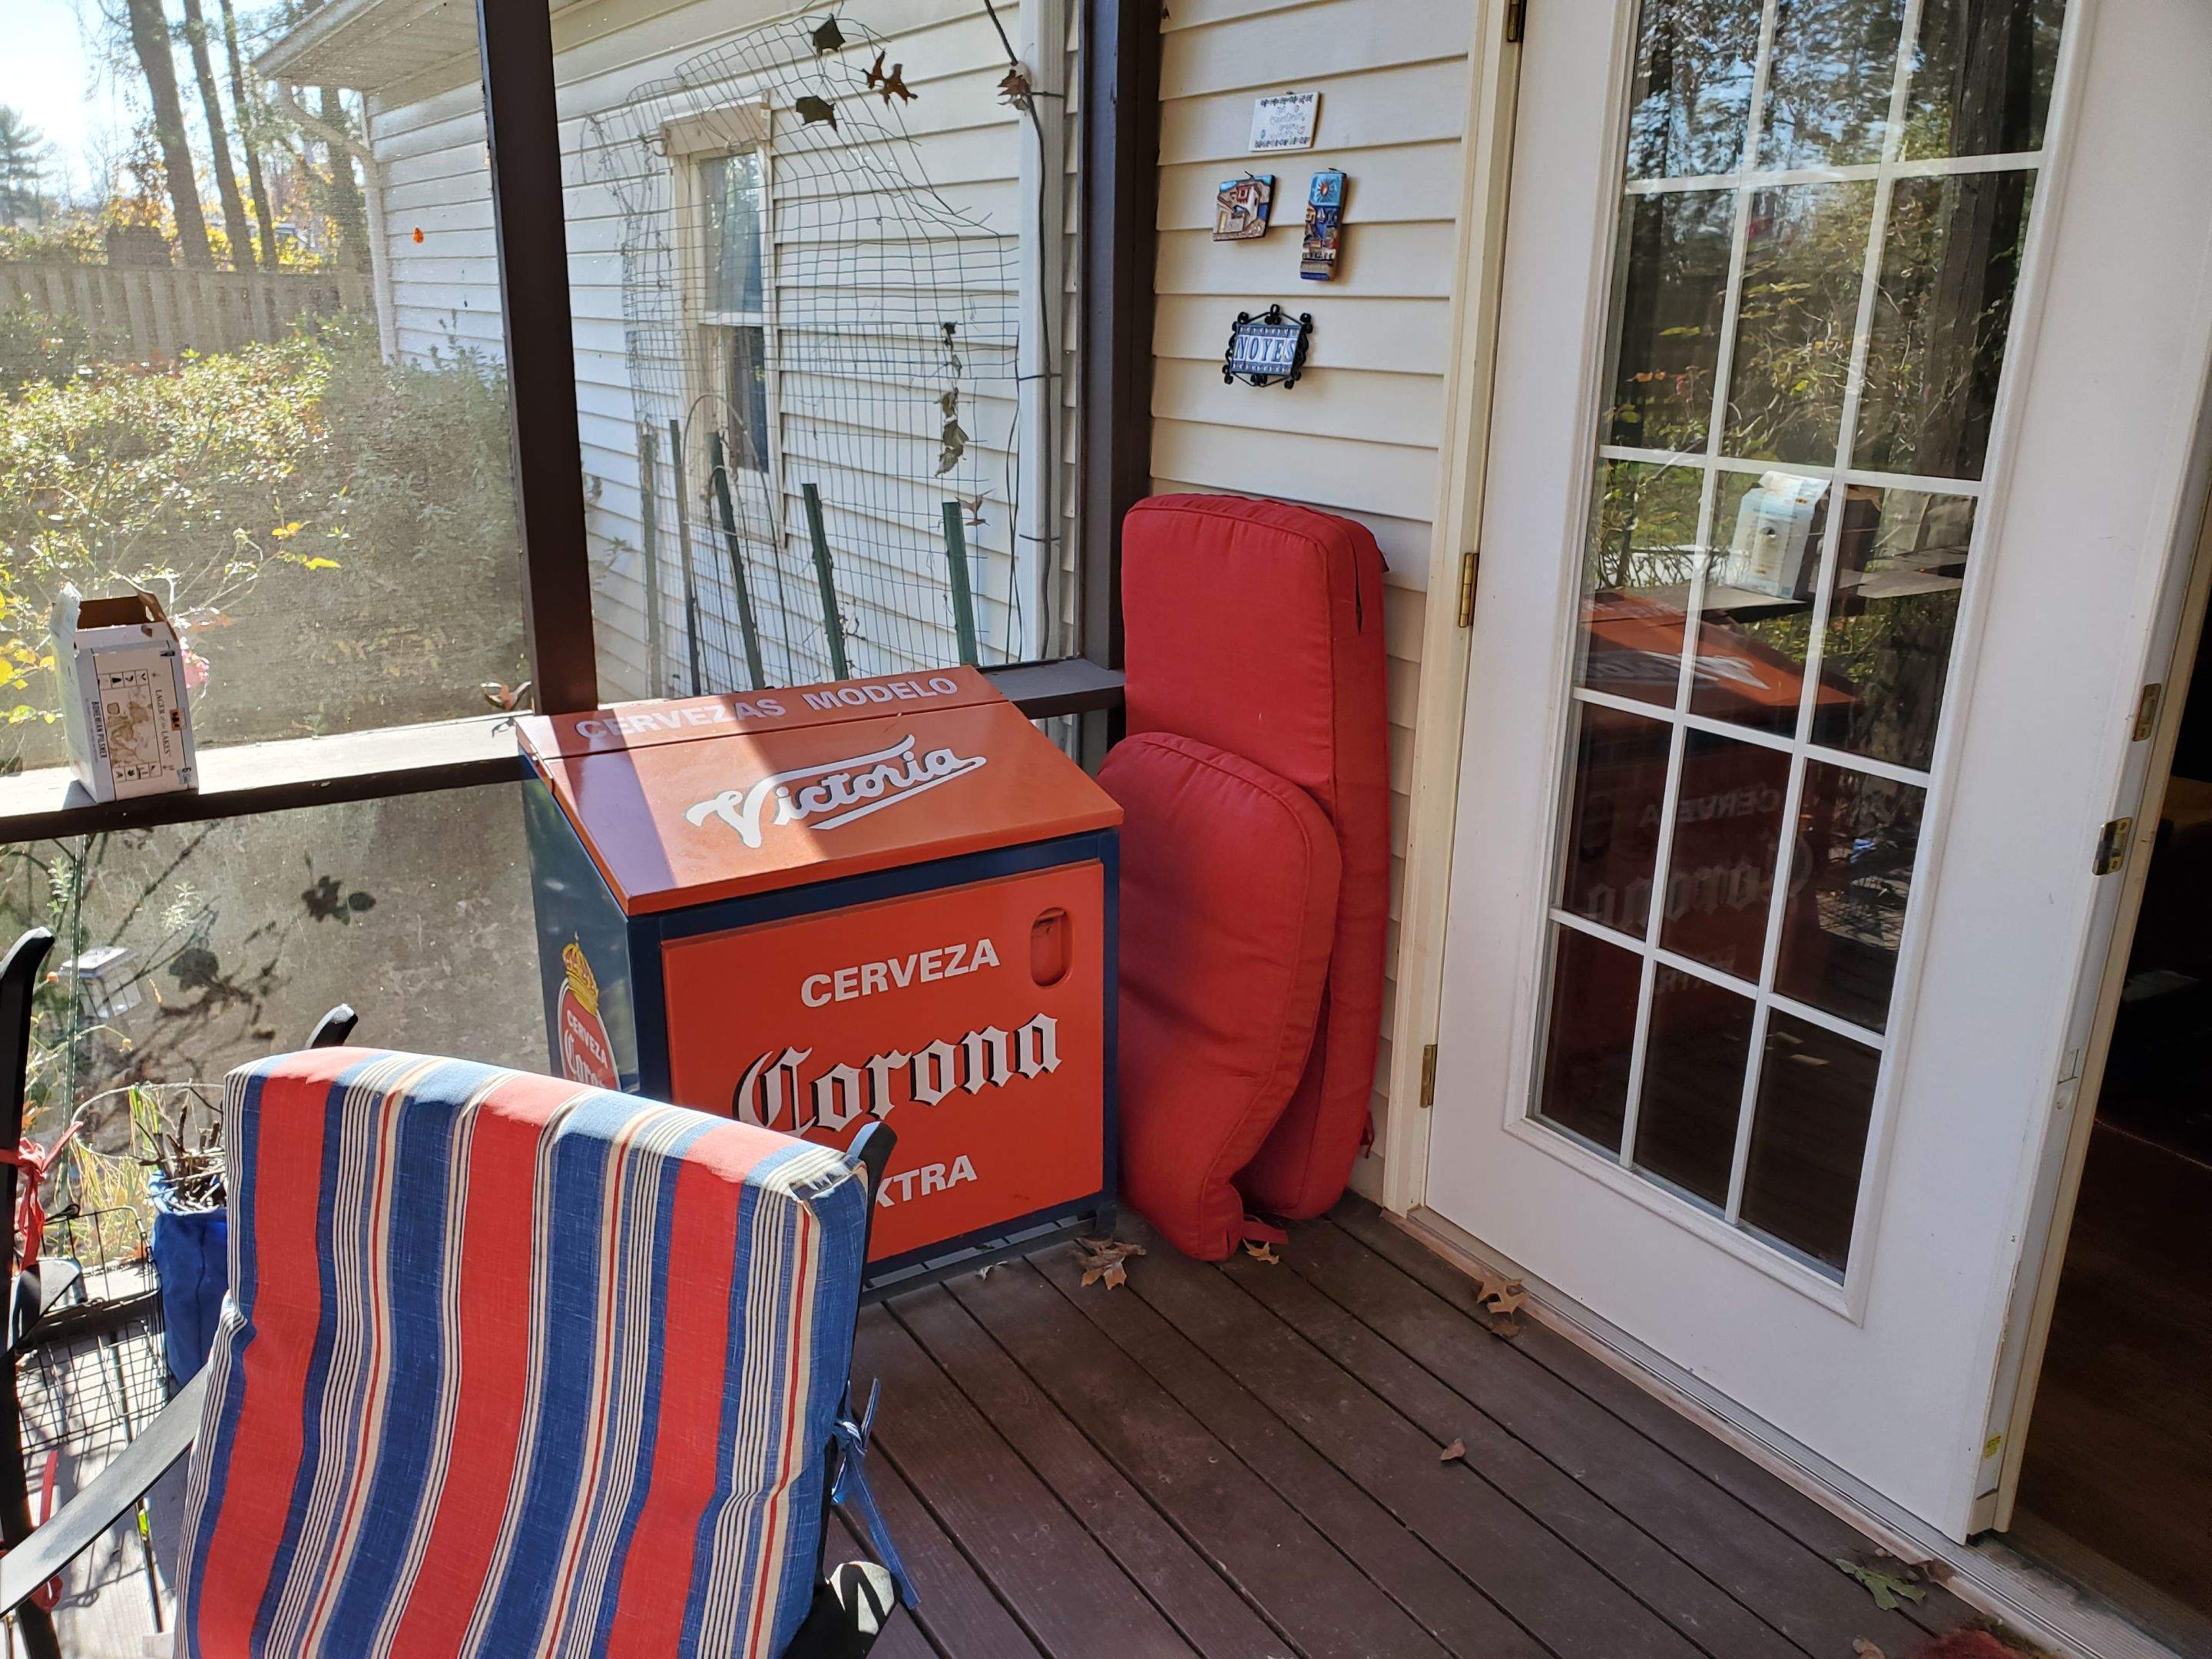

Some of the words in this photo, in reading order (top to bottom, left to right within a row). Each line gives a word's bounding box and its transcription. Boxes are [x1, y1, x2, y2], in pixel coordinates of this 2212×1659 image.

[1237, 335, 1296, 362] NOYES
[155, 689, 166, 715] LAGER
[162, 731, 172, 756] LAKES
[576, 697, 786, 739] CERVEZAS
[803, 677, 958, 711] MODELO
[686, 734, 987, 848] Victoria
[801, 938, 1000, 1008] CERVEZA
[566, 1009, 608, 1069] CERVEZA
[733, 1012, 1064, 1137] Corona
[875, 1154, 978, 1208] XTRA
